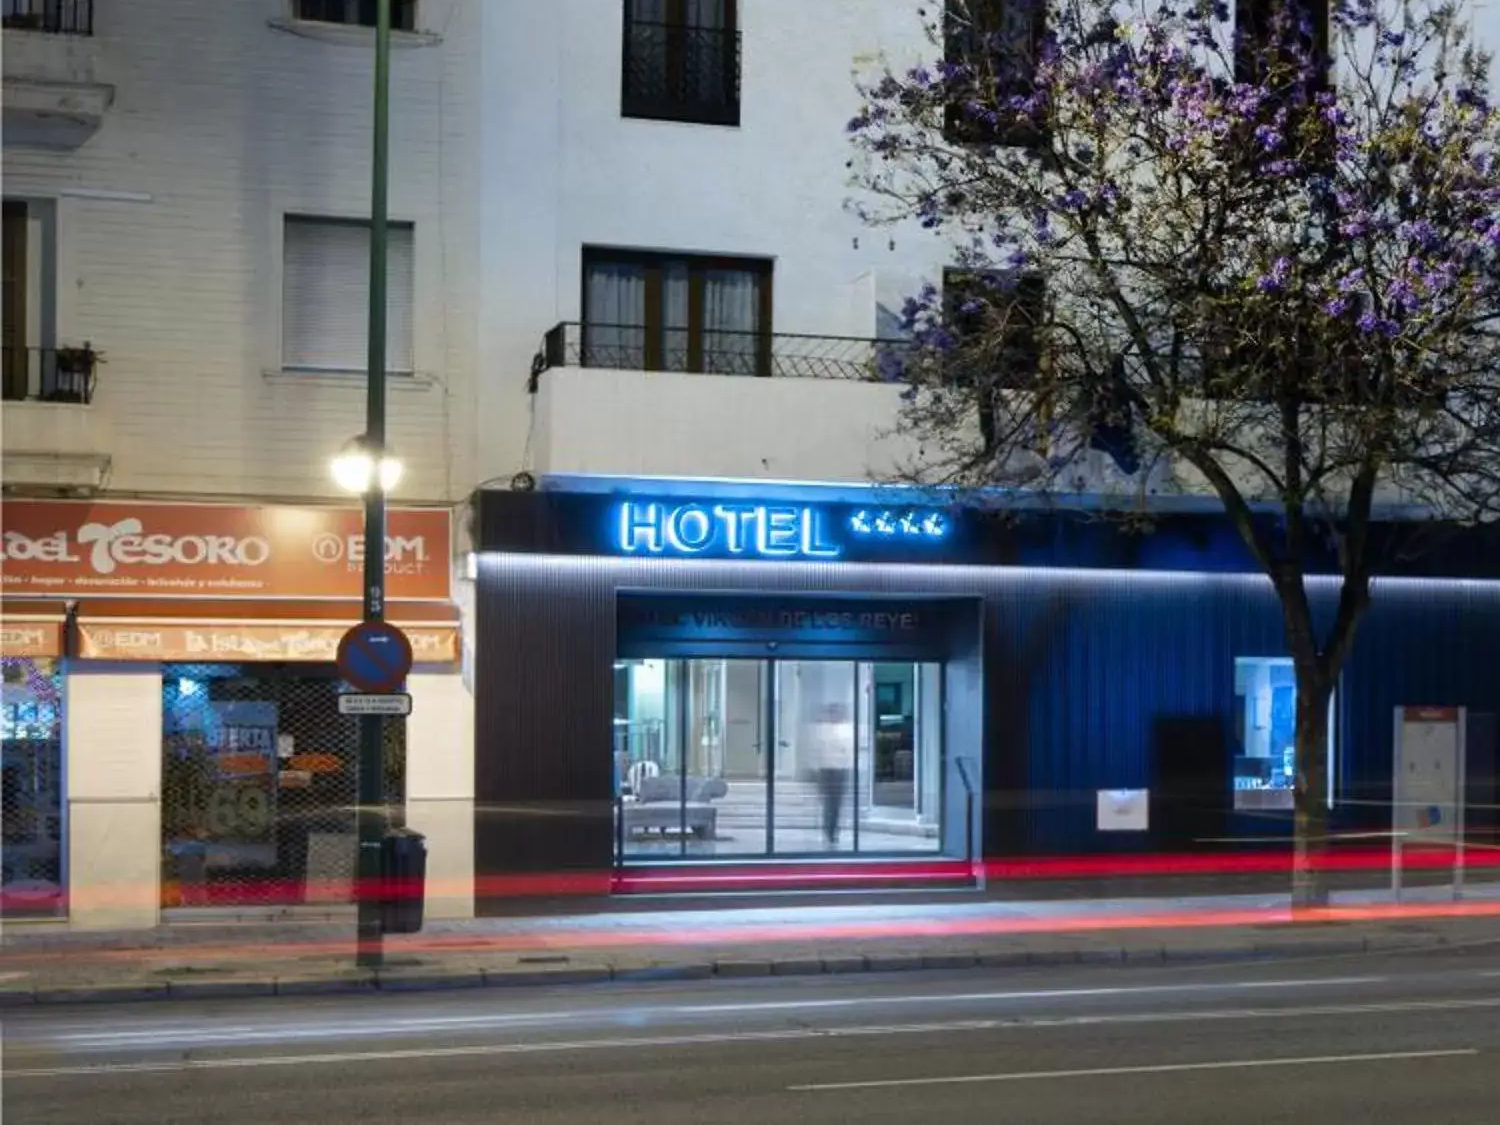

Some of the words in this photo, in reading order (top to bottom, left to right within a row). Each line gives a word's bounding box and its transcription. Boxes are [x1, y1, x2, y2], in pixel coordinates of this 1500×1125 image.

[619, 501, 841, 557] HOTEL
[859, 611, 919, 631] REYE
[114, 631, 161, 647] EDM
